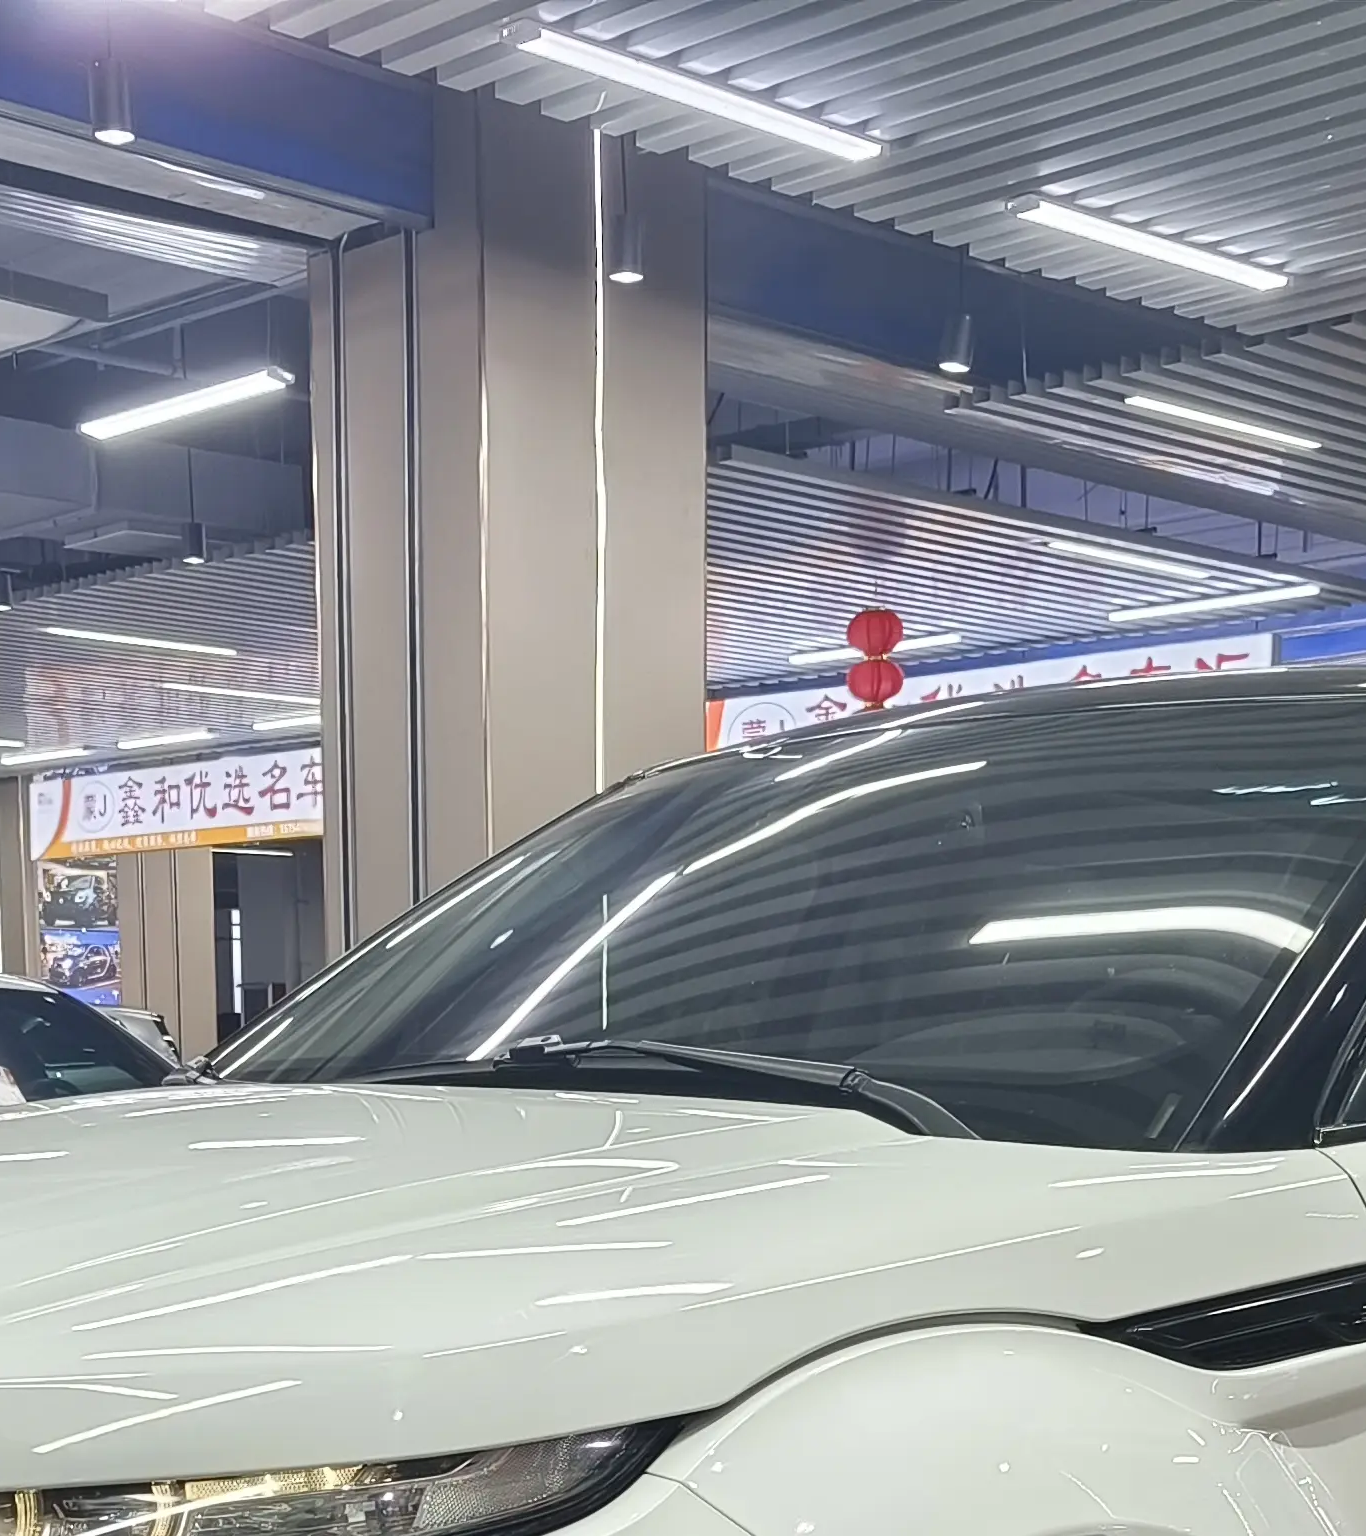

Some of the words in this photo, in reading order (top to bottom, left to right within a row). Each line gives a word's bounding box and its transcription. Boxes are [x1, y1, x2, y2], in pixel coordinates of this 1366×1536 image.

[117, 755, 324, 827] 鑫和优选名车
